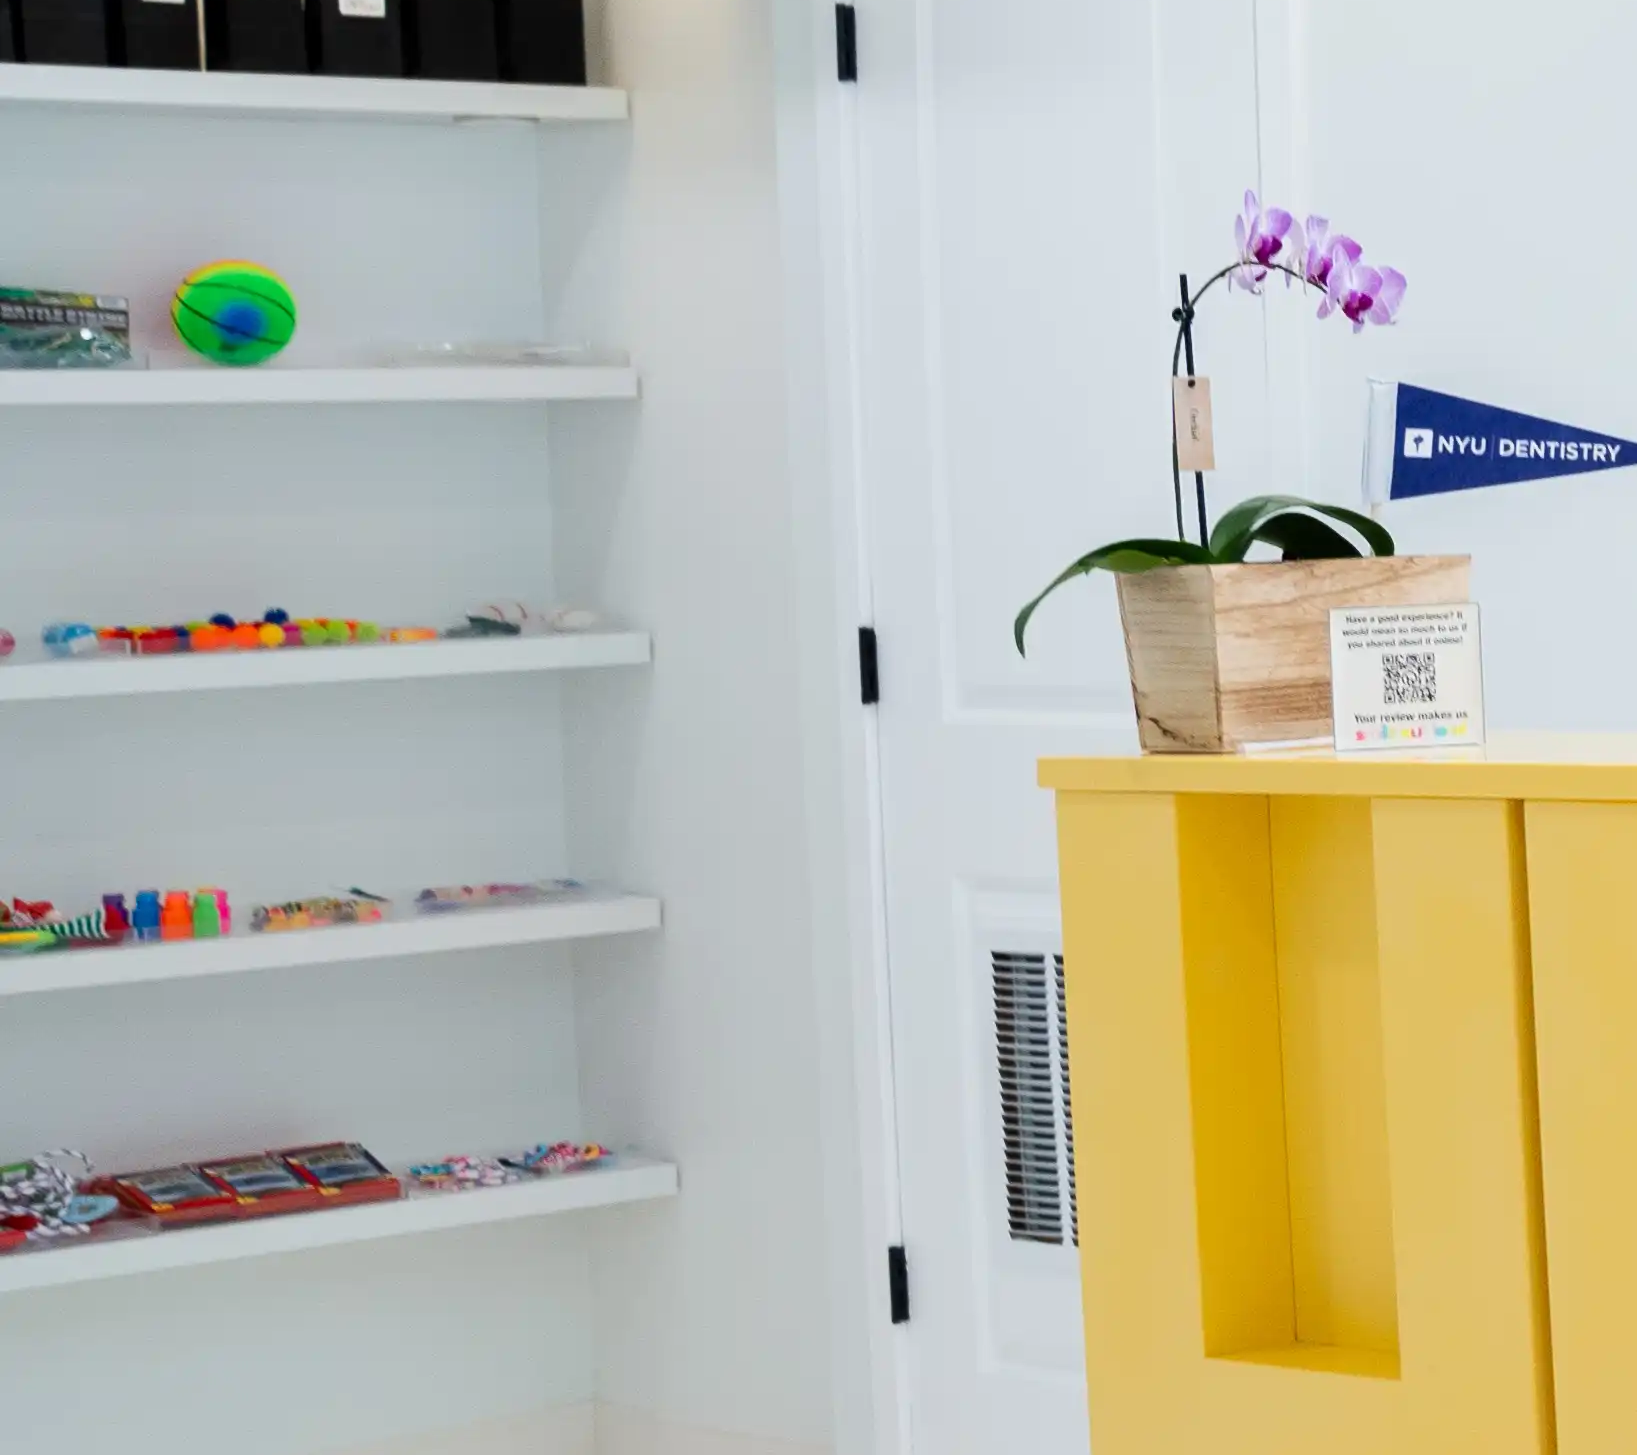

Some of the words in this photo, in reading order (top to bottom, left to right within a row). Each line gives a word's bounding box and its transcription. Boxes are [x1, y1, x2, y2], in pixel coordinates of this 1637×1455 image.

[1438, 434, 1486, 456] NYU
[1499, 437, 1620, 463] DENTISTRY
[1354, 713, 1376, 723] Your
[1381, 711, 1414, 722] review
[1418, 711, 1452, 720] makes
